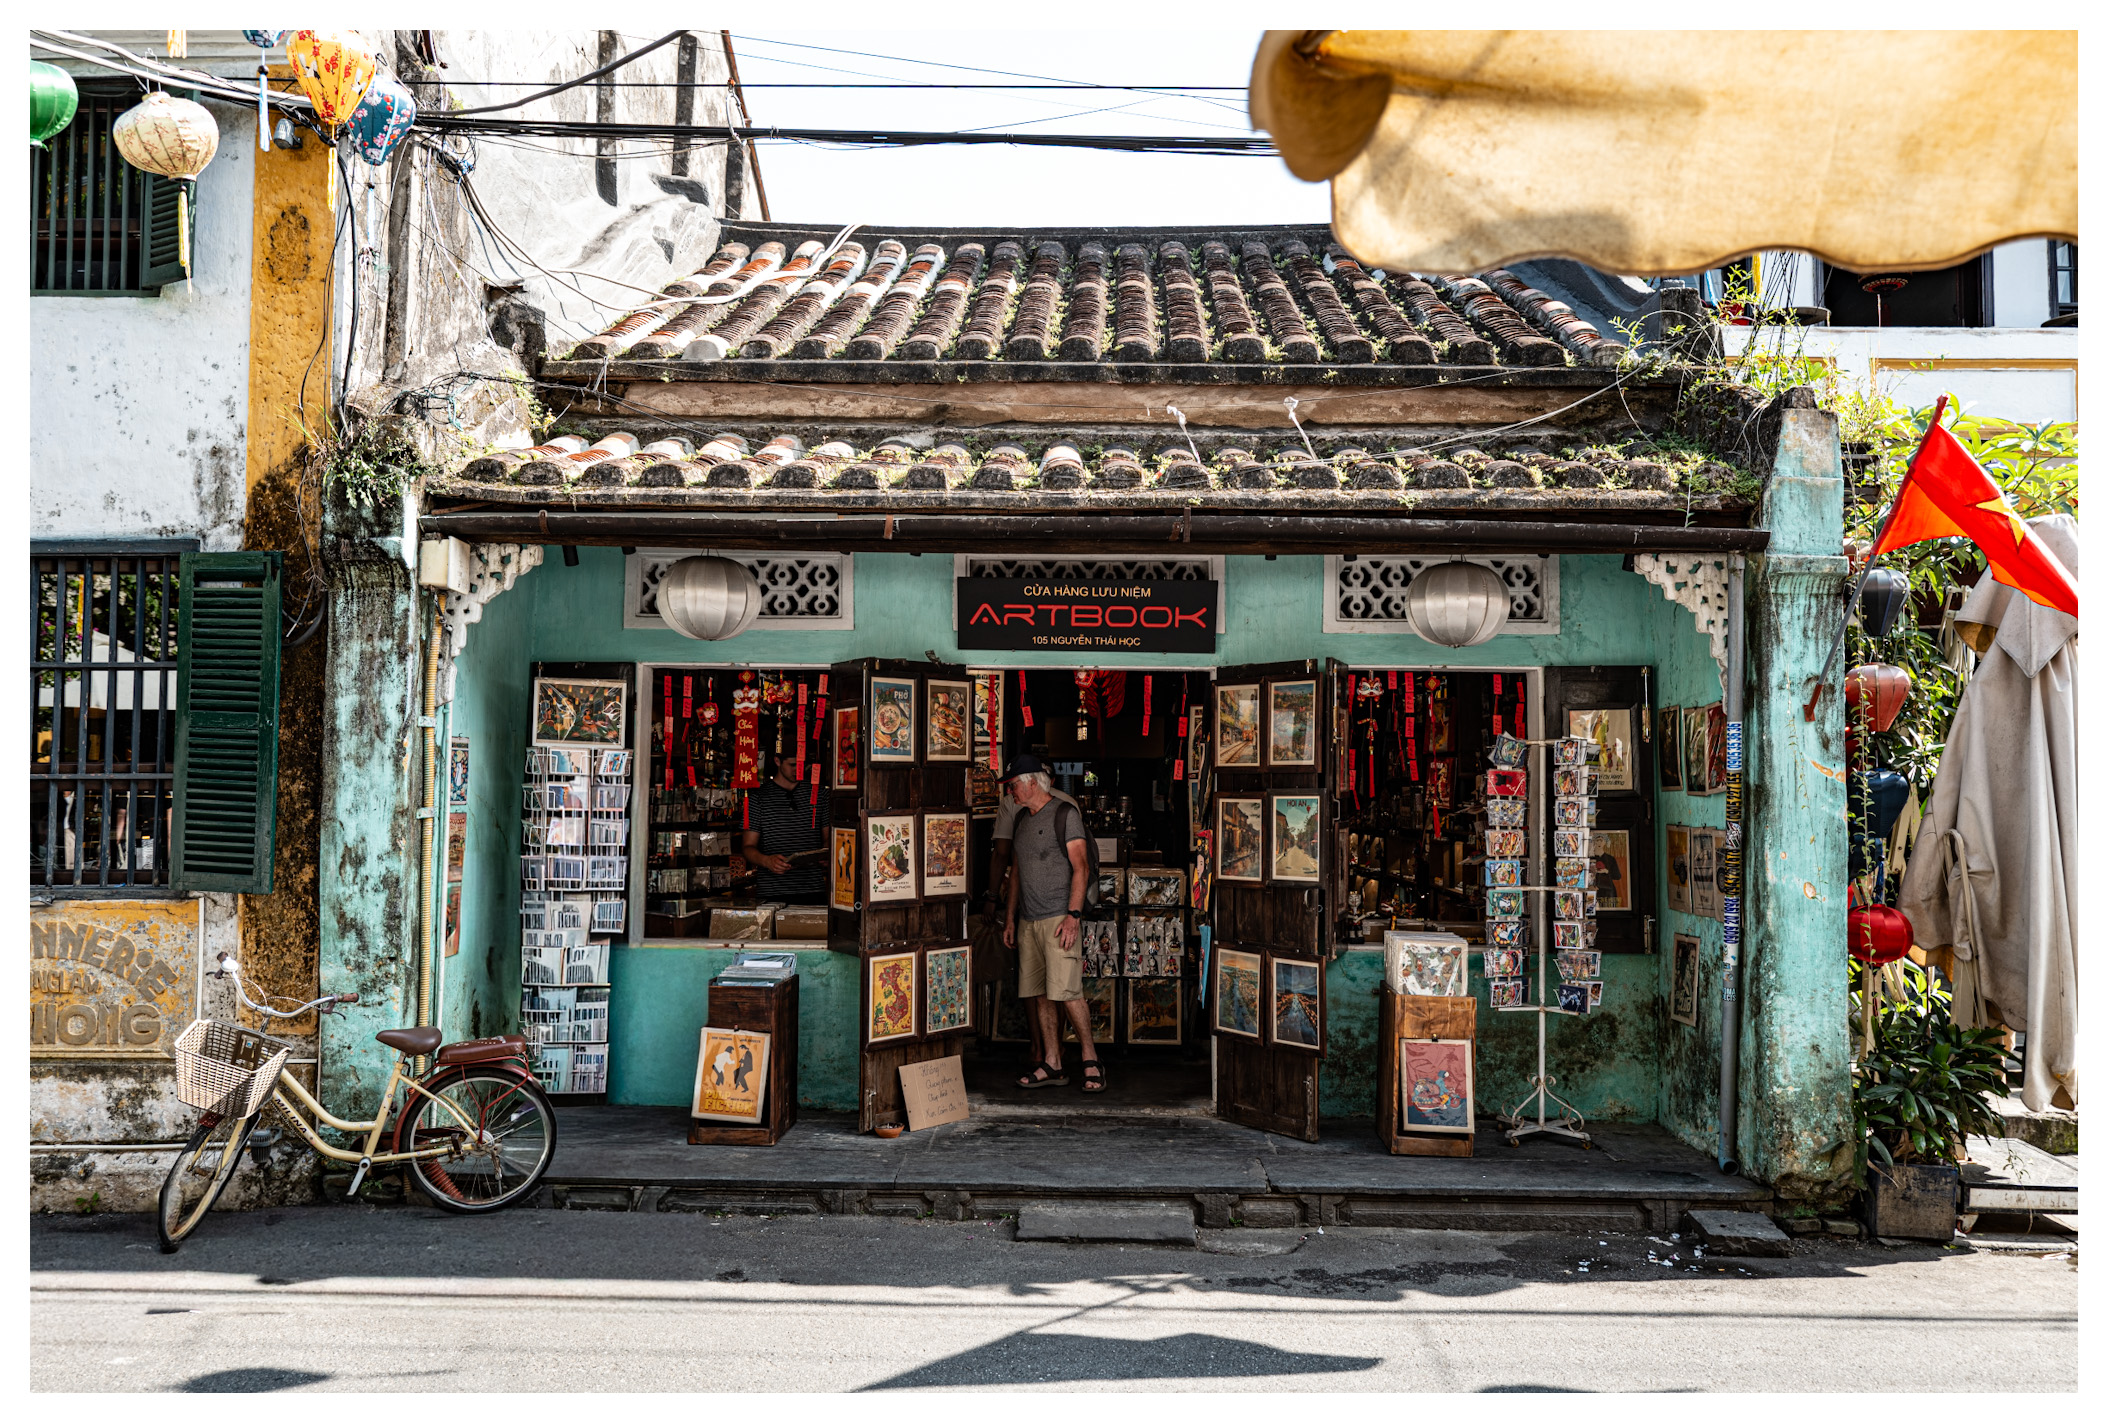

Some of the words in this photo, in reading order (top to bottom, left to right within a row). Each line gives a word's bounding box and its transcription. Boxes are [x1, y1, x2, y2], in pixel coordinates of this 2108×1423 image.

[1024, 583, 1051, 597] CỬA
[1054, 584, 1089, 598] HÀNG
[1092, 587, 1118, 598] LƯU
[1120, 585, 1151, 599] NIỆM
[969, 603, 1207, 629] ARTBOOK
[1032, 636, 1048, 645] 105
[1050, 633, 1092, 646] NGUYỄN
[1094, 635, 1117, 646] THÁI
[1118, 637, 1141, 647] HỌC
[30, 1003, 161, 1045] HONG
[274, 1098, 307, 1134] MILINA
